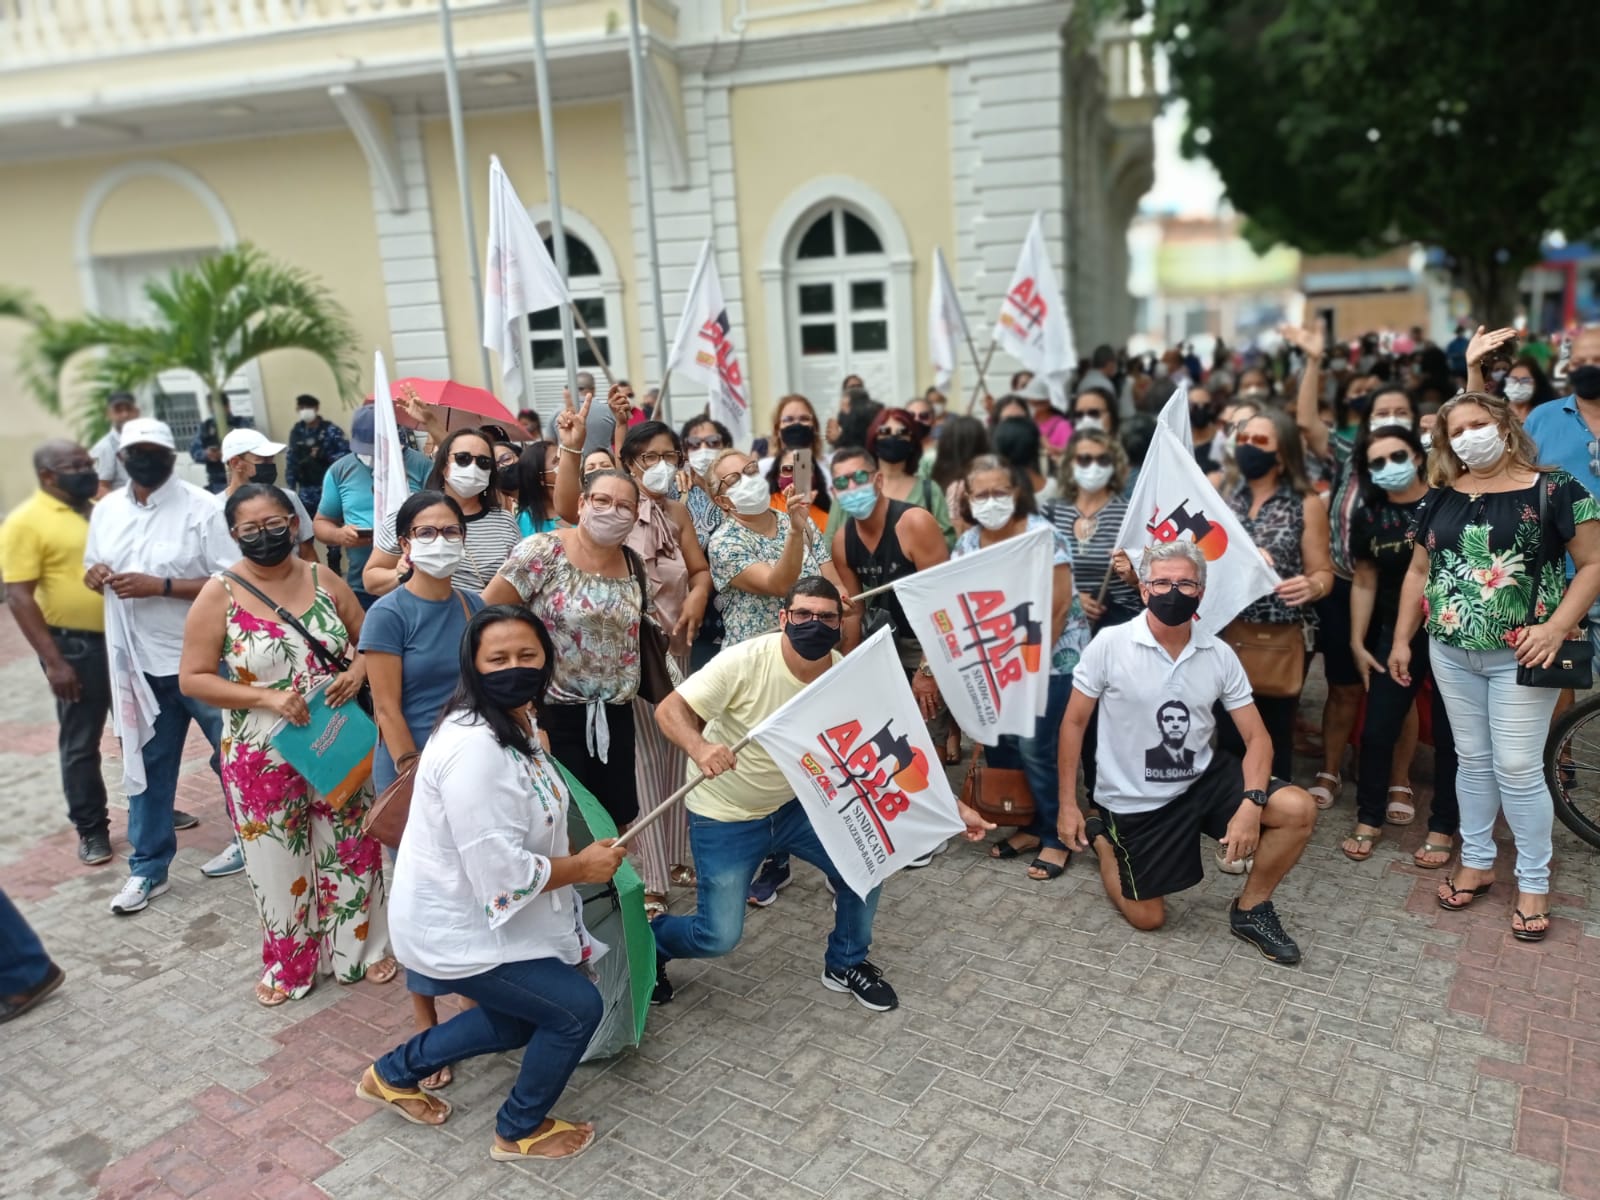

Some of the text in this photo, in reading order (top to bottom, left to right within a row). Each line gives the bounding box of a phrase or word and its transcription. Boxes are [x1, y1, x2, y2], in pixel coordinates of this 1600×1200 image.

[967, 590, 1022, 690] APLB
[972, 668, 998, 725] SINDICATO
[825, 719, 910, 822] APLB
[1145, 767, 1200, 779] BOLSONAR
[842, 815, 876, 876] JUAZEIRO-BAHIA
[852, 804, 887, 865] SINDICATO
